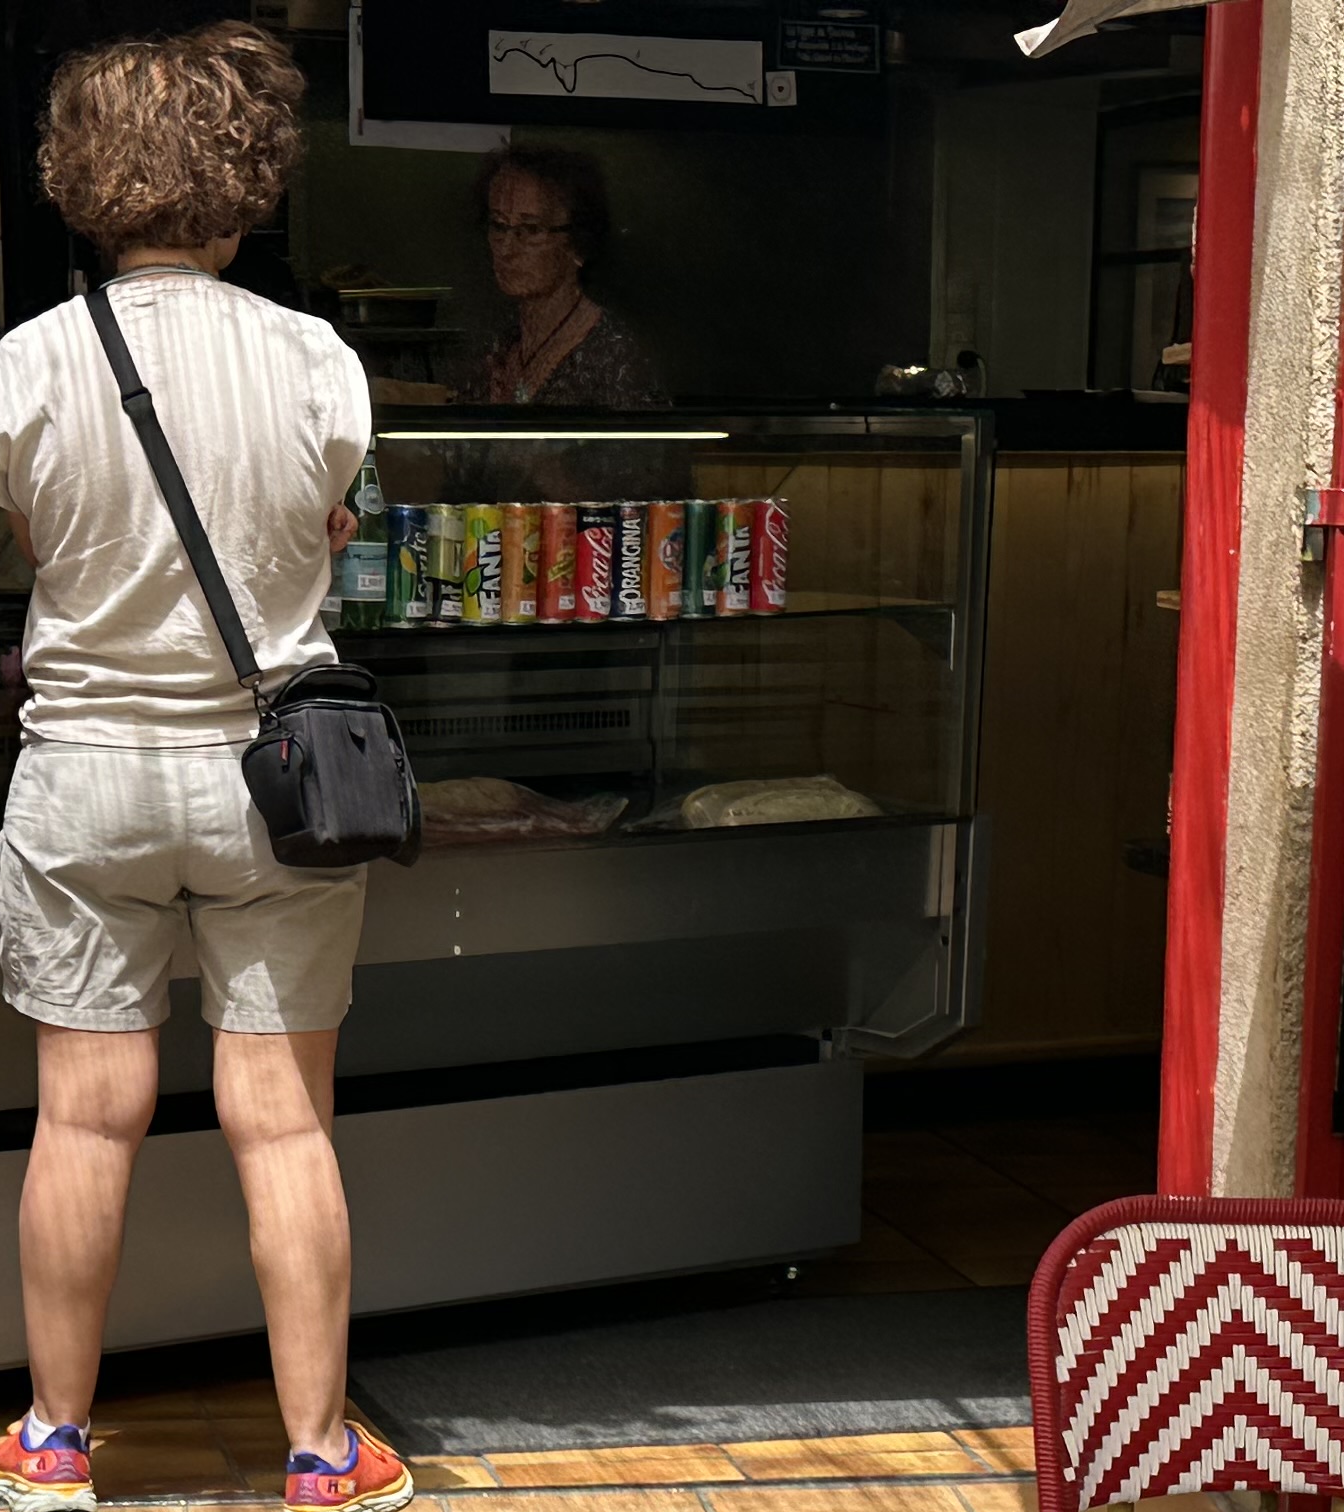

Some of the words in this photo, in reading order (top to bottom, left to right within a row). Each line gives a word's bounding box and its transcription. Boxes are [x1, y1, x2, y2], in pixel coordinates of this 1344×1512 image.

[478, 530, 501, 603] FANTA
[619, 518, 641, 602] ORANGINA
[730, 526, 750, 597] FANTA
